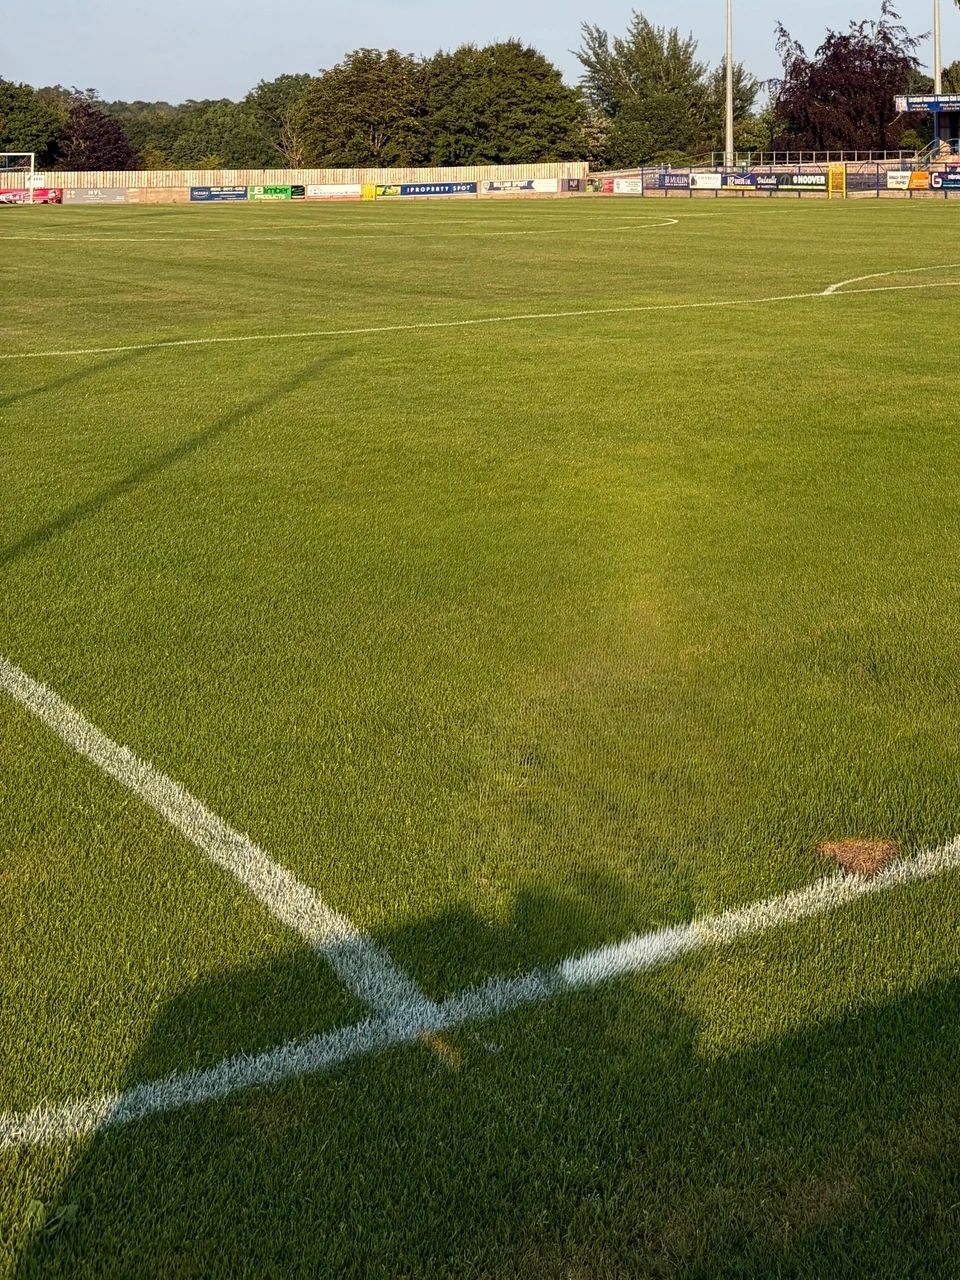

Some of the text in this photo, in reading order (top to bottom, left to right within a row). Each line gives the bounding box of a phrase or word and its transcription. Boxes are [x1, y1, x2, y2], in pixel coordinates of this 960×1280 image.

[798, 175, 826, 184] HOOVER
[410, 184, 449, 193] PROPERTY
[453, 184, 471, 192] SPOT
